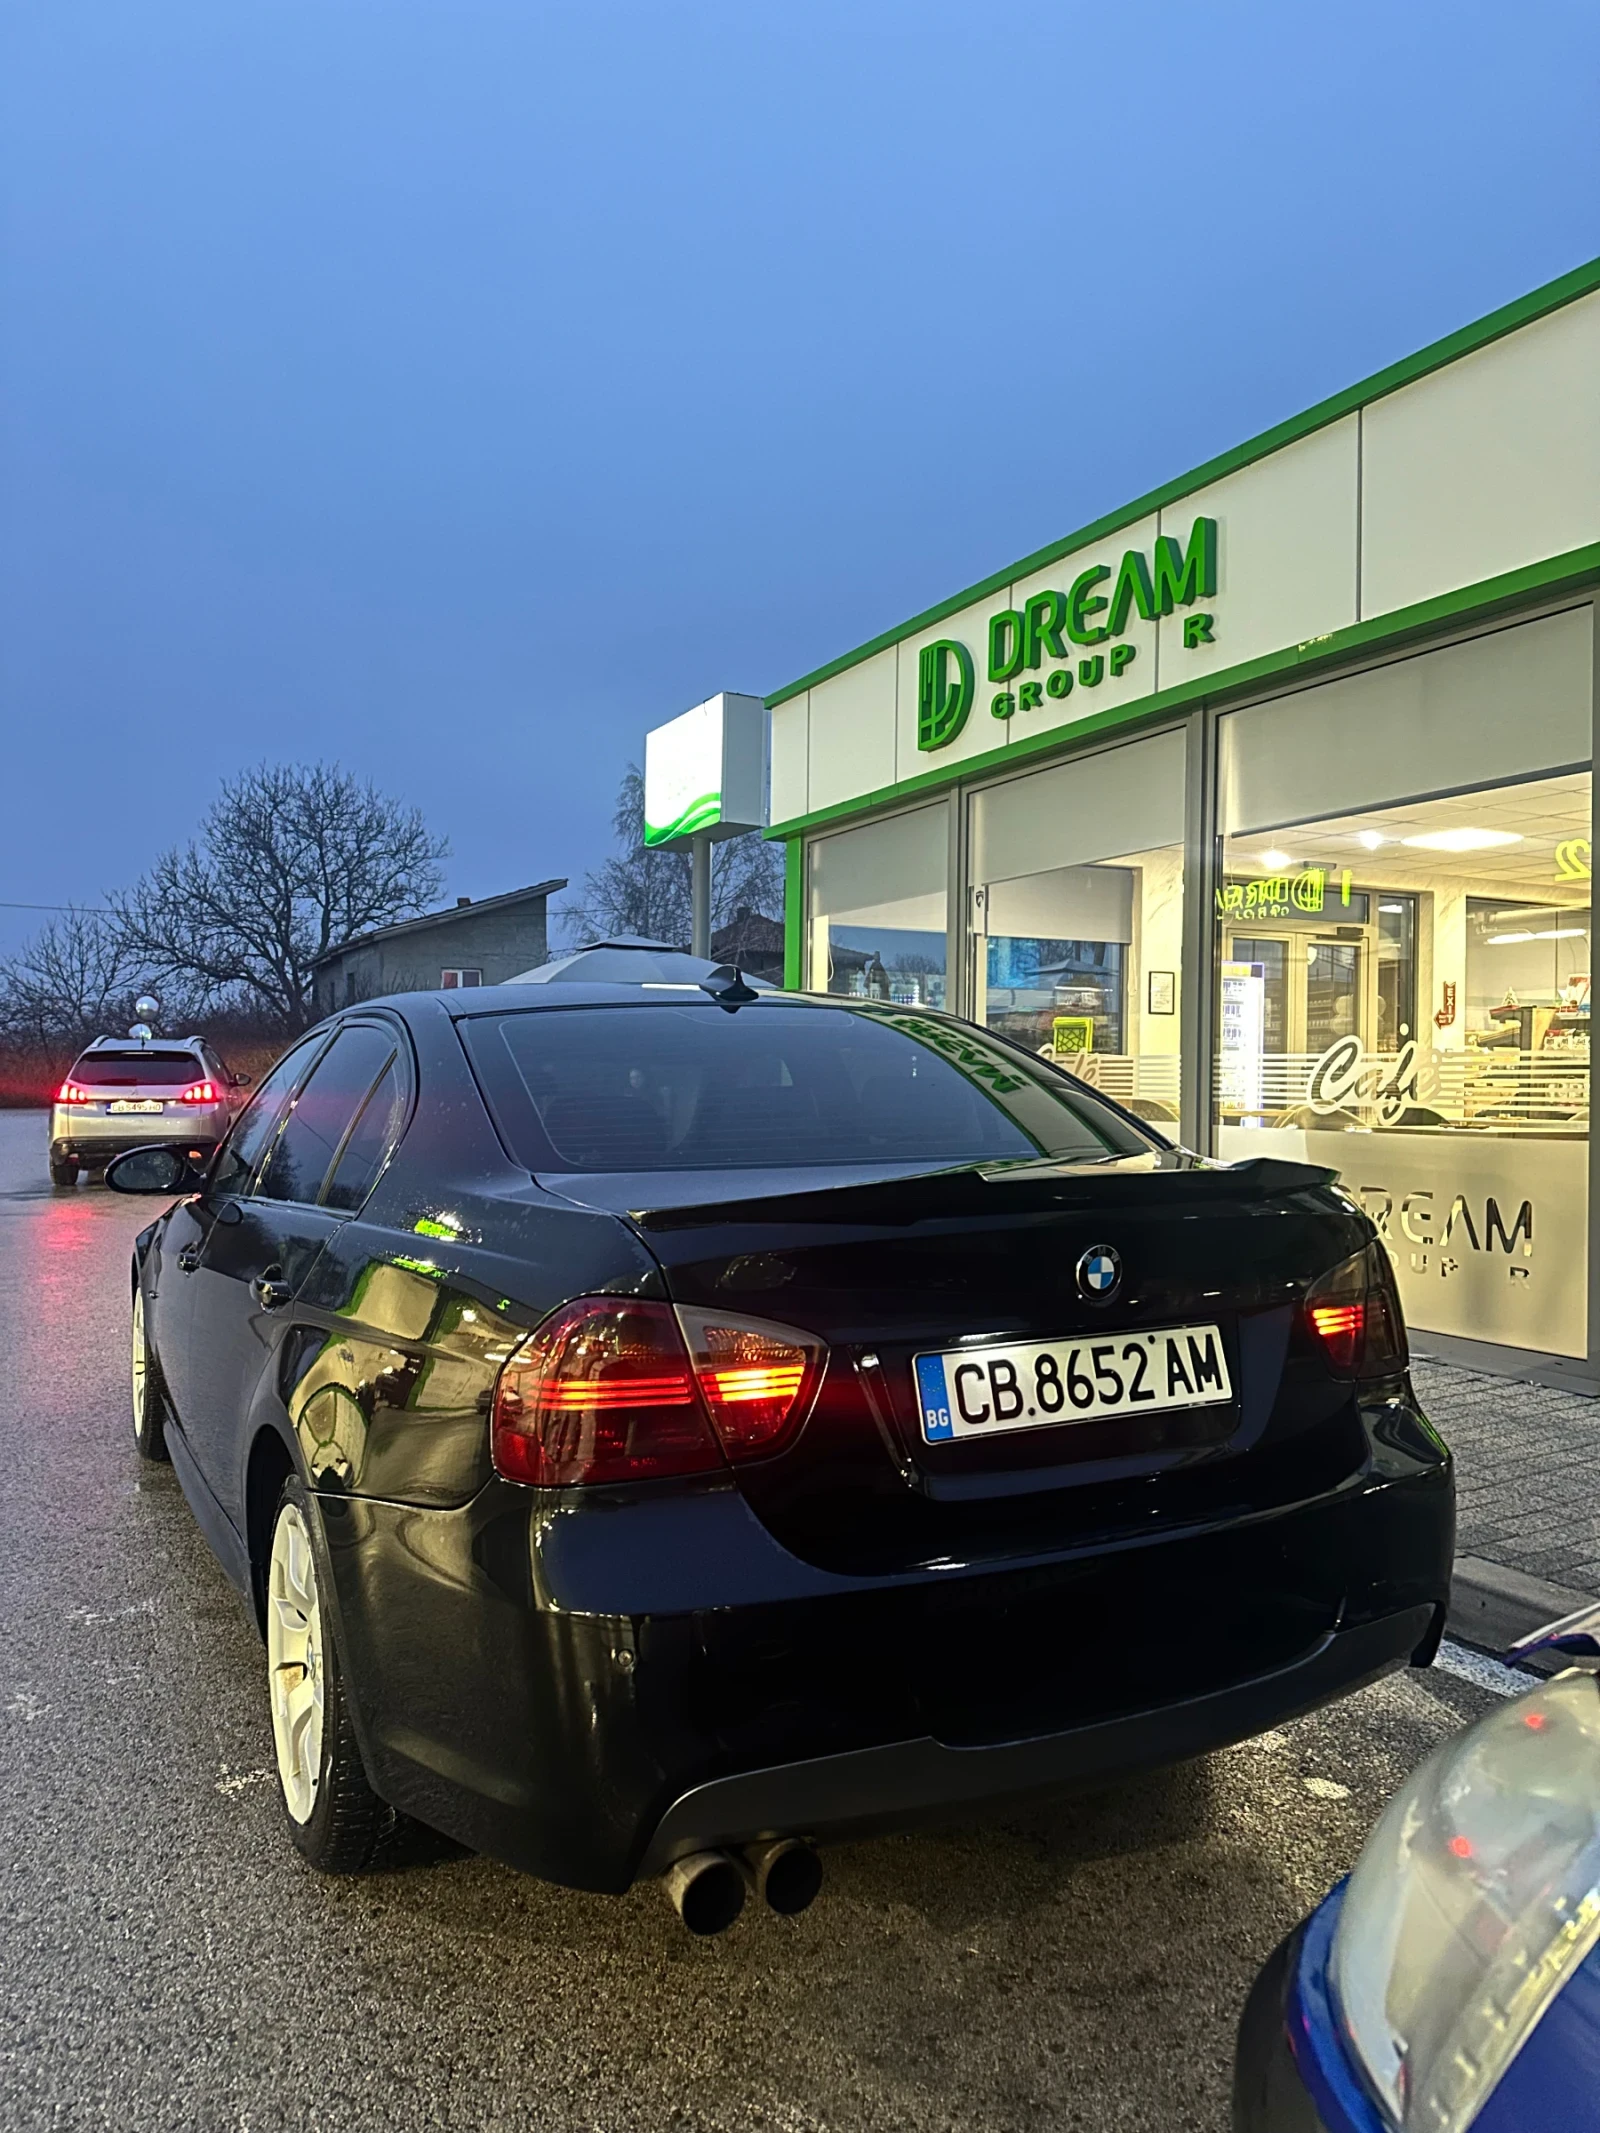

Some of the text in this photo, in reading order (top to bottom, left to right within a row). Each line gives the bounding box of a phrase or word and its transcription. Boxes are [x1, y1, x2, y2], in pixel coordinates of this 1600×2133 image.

[988, 516, 1217, 683] DREAM
[991, 613, 1216, 720] GROUP R
[1446, 987, 1454, 1024] EXIT
[1336, 1184, 1532, 1257] REAM
[1082, 1246, 1121, 1264] BMW
[926, 1409, 949, 1429] BG
